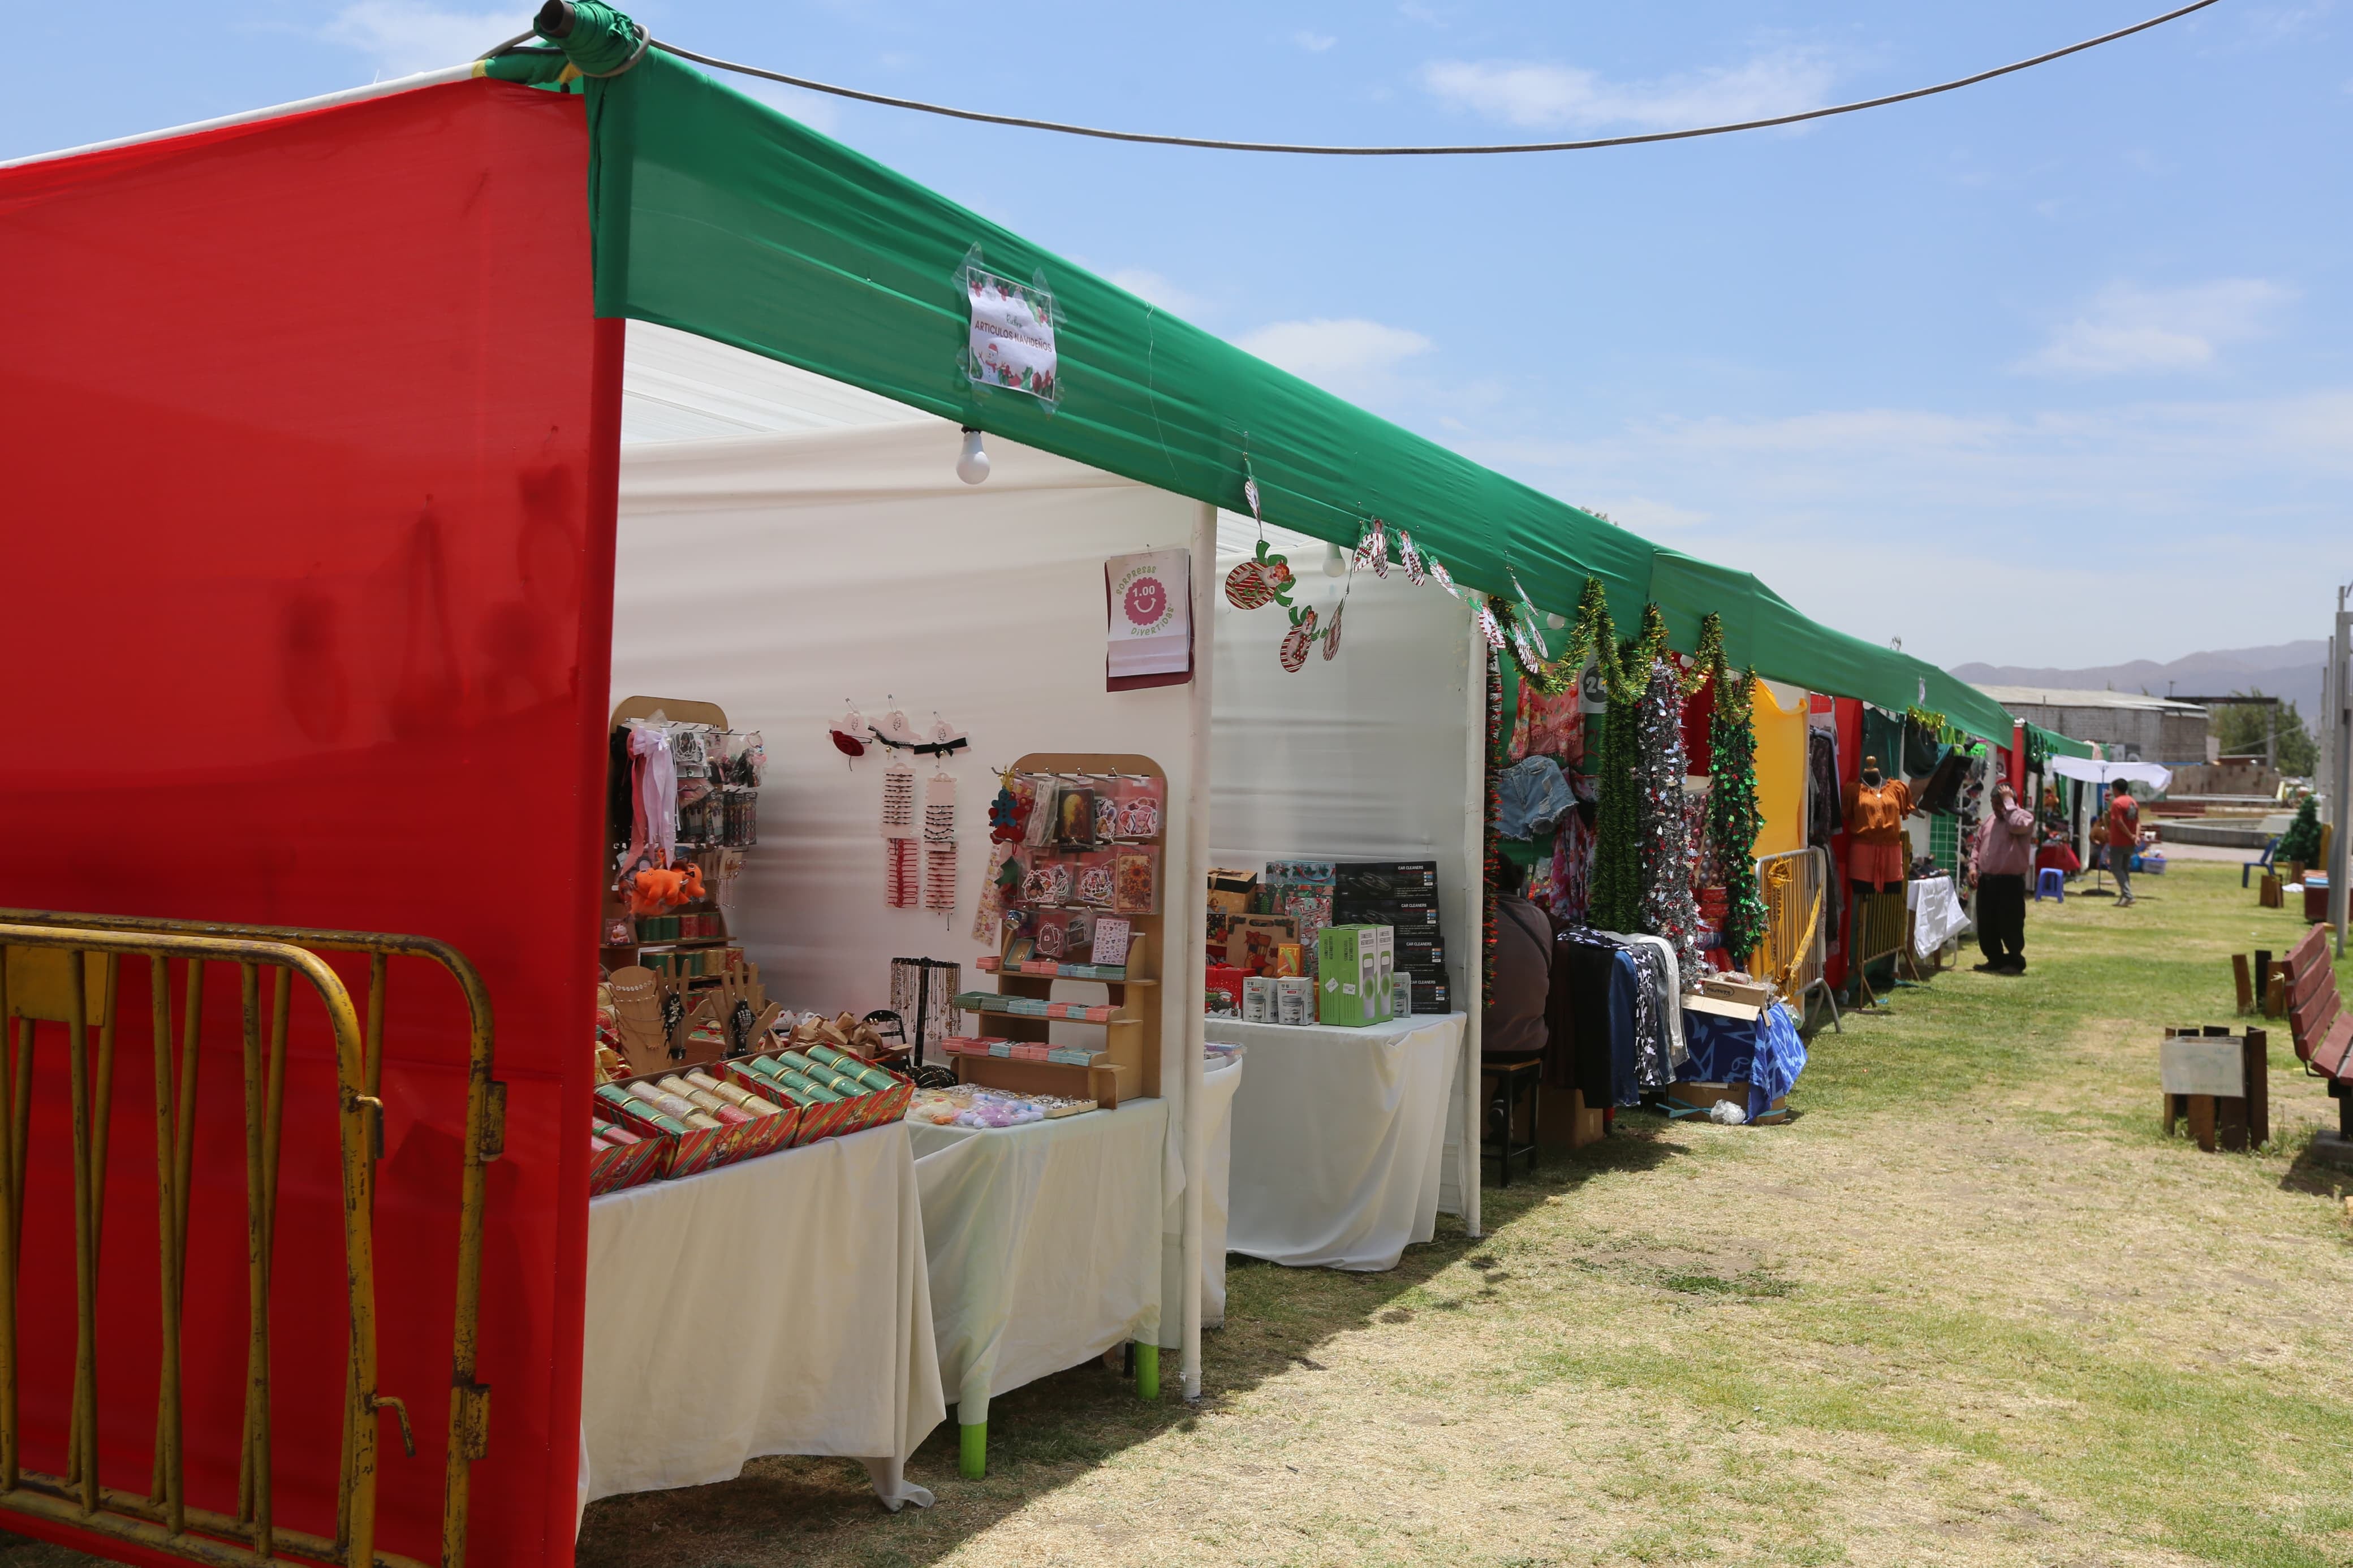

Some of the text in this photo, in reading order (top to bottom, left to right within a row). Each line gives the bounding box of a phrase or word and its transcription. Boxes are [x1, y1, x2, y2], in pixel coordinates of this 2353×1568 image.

[975, 320, 1052, 352] ARTICULOS NAVIDEÑOS
[1132, 585, 1155, 597] 1.00
[1585, 676, 1608, 694] 24
